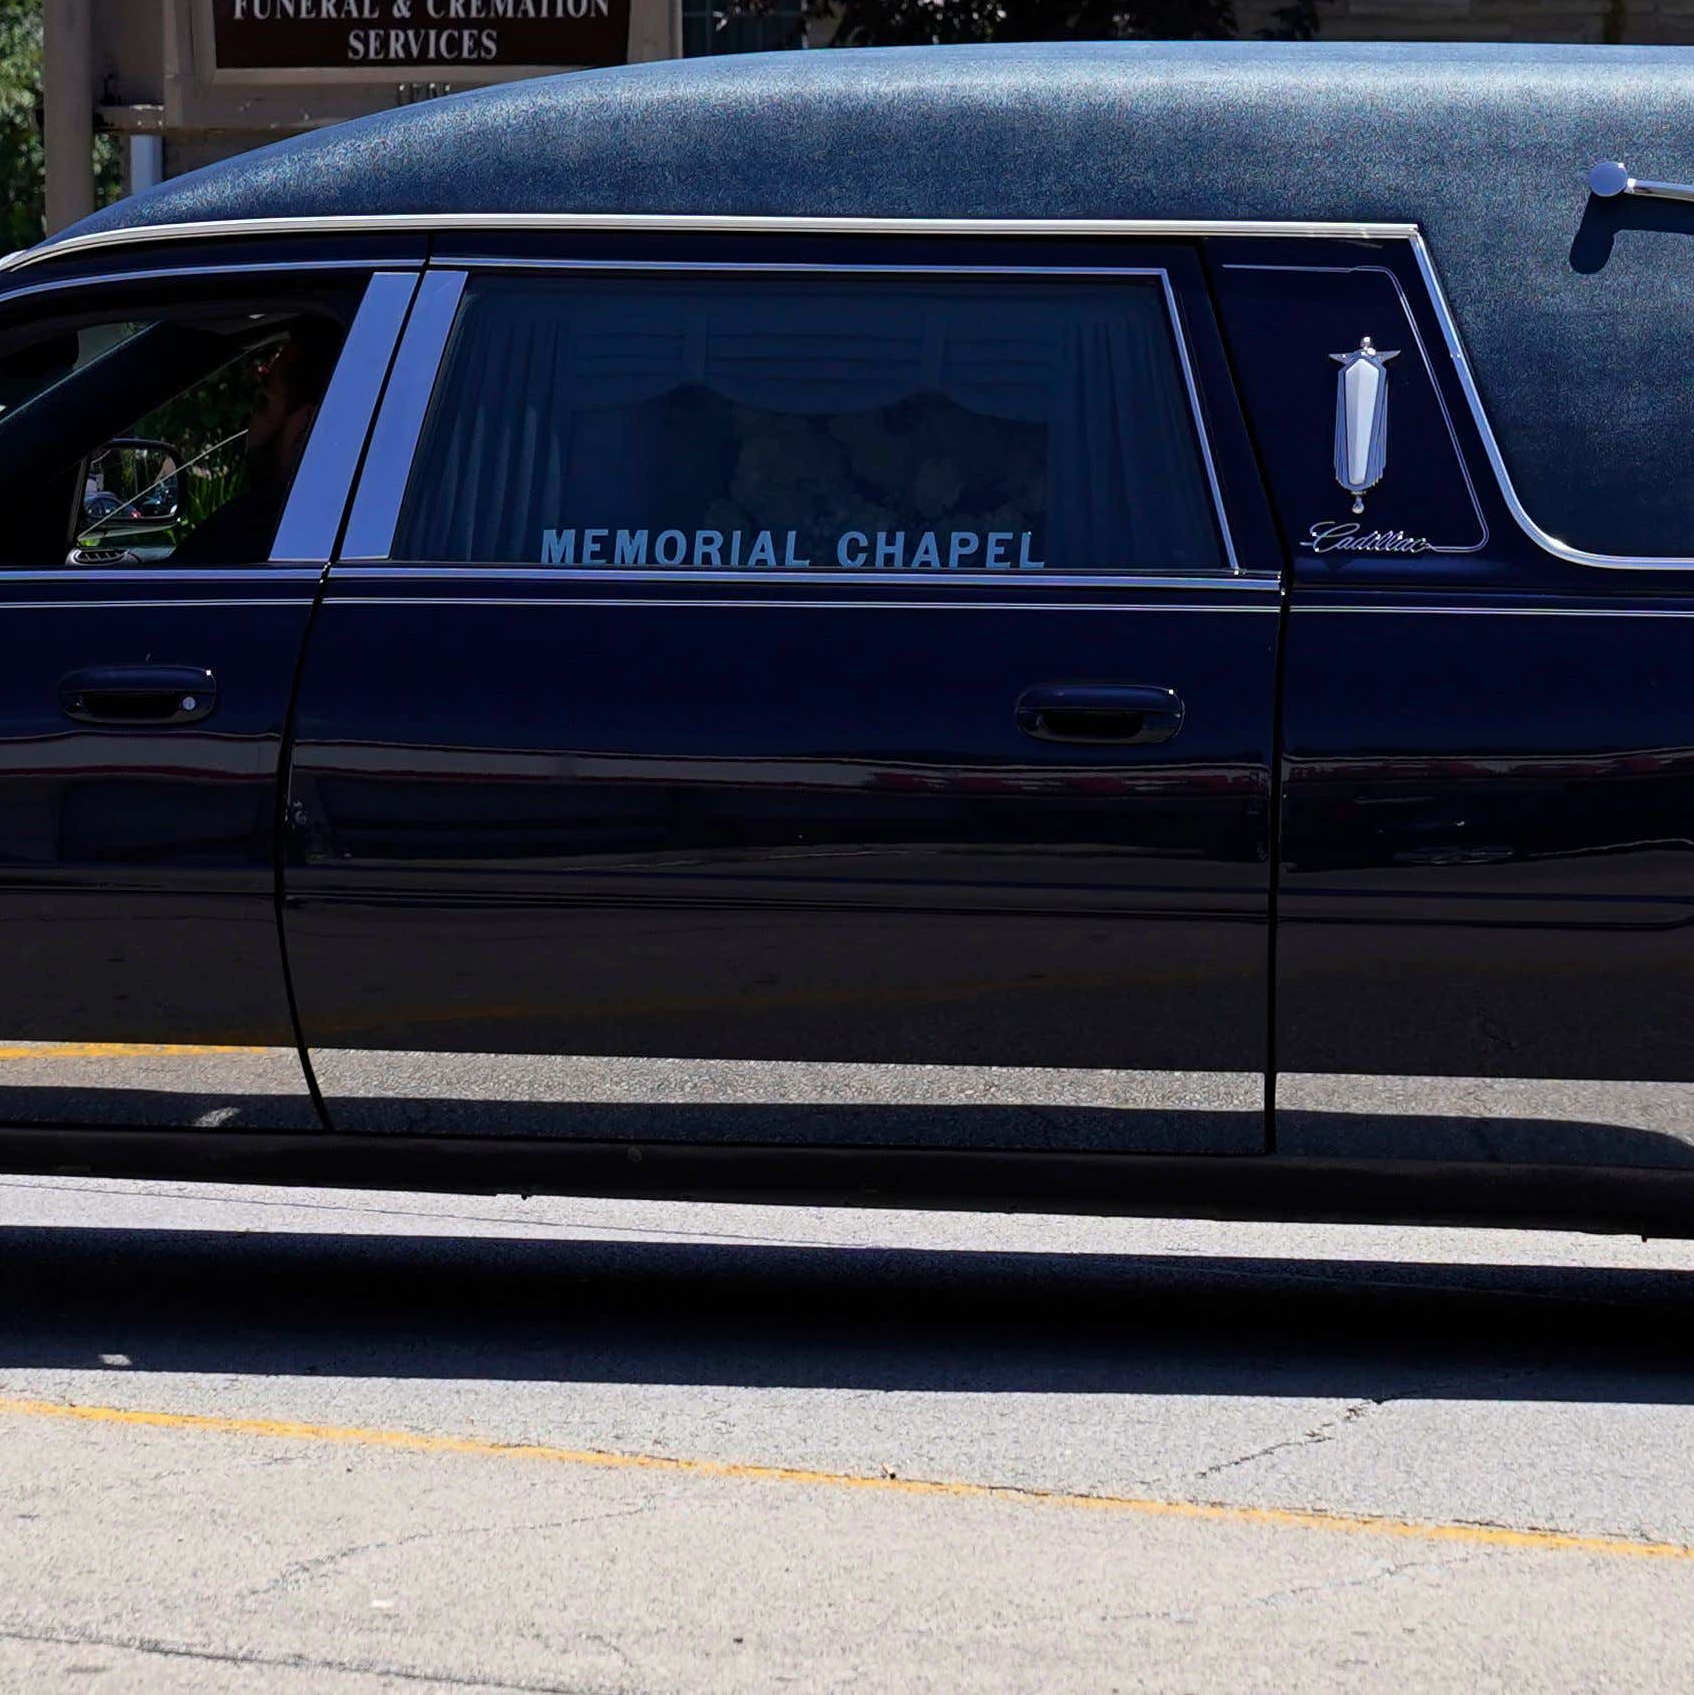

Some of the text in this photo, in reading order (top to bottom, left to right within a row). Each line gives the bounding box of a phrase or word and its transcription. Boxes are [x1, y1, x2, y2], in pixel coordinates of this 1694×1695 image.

[347, 29, 497, 60] SERVICES
[540, 528, 1045, 570] MEMORIAL CHAPEL
[1308, 521, 1433, 553] Cadillac
